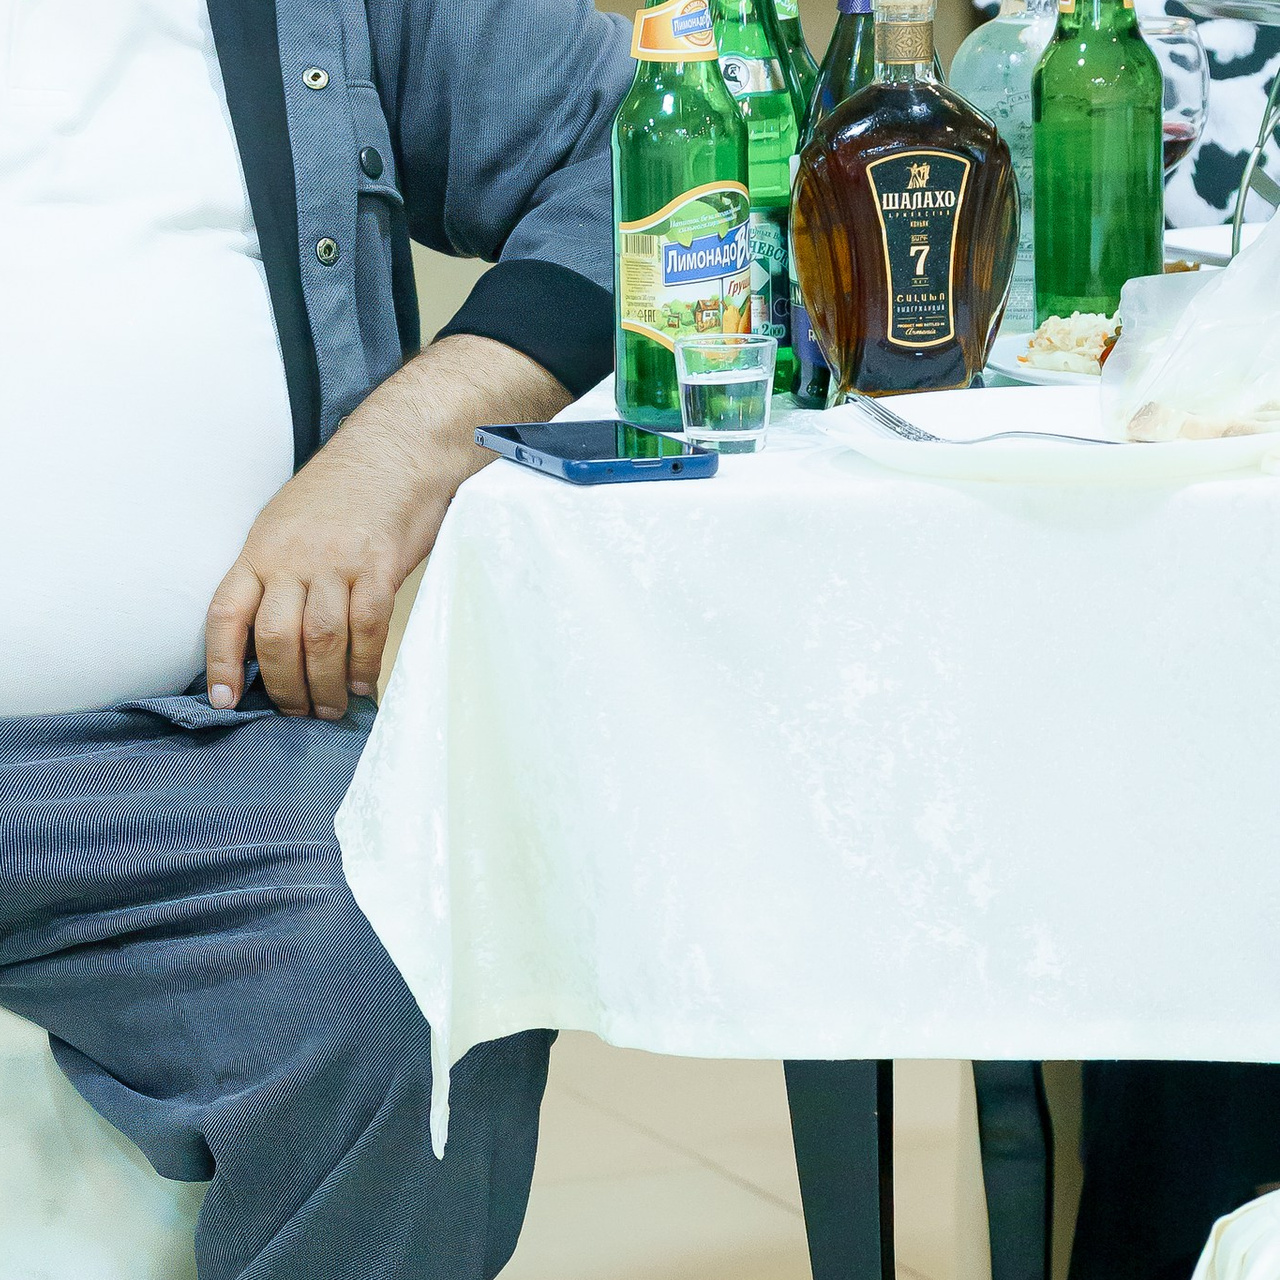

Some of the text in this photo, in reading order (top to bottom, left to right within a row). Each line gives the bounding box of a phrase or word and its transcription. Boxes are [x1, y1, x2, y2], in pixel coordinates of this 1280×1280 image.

[882, 190, 956, 210] ШАЛАХО
[909, 245, 930, 276] 7
[905, 328, 937, 336] Armenia
